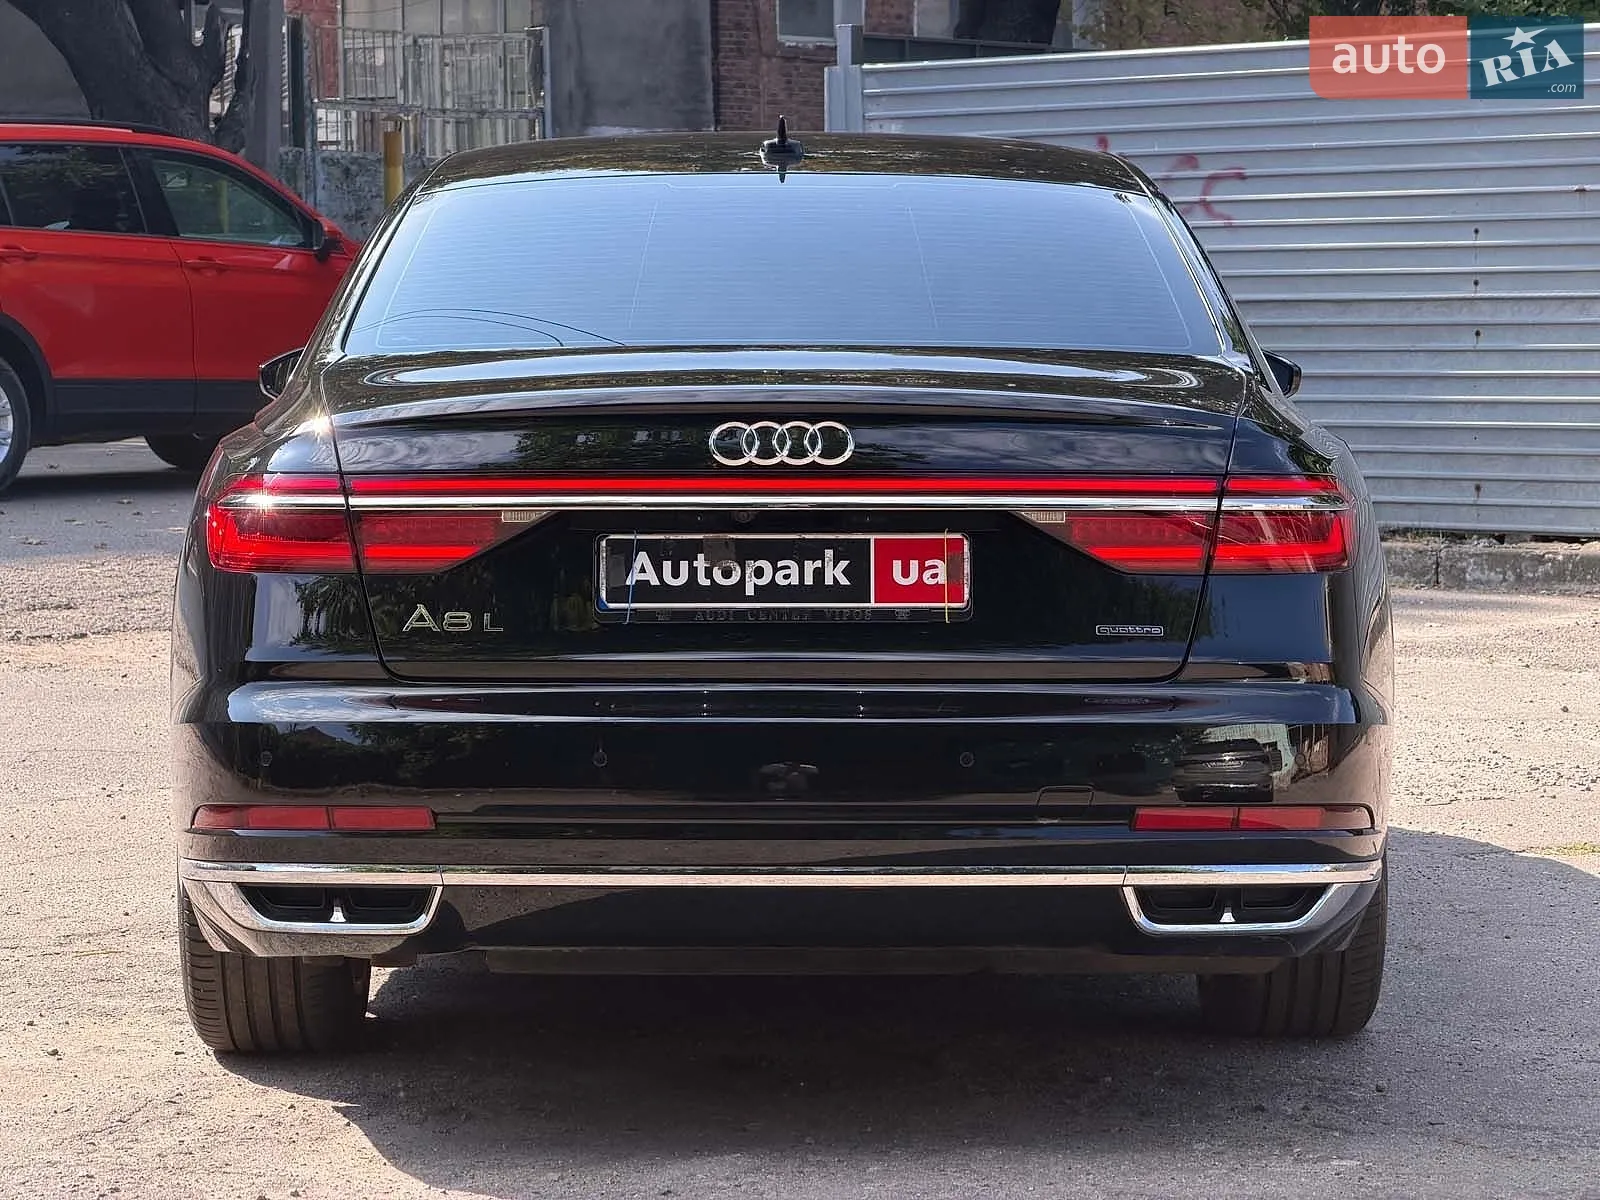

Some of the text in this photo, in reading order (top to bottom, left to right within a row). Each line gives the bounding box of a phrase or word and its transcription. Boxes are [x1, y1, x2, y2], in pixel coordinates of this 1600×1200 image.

[626, 548, 945, 596] Autopark ua
[402, 603, 504, 632] A8 L
[1099, 626, 1161, 635] quattro
